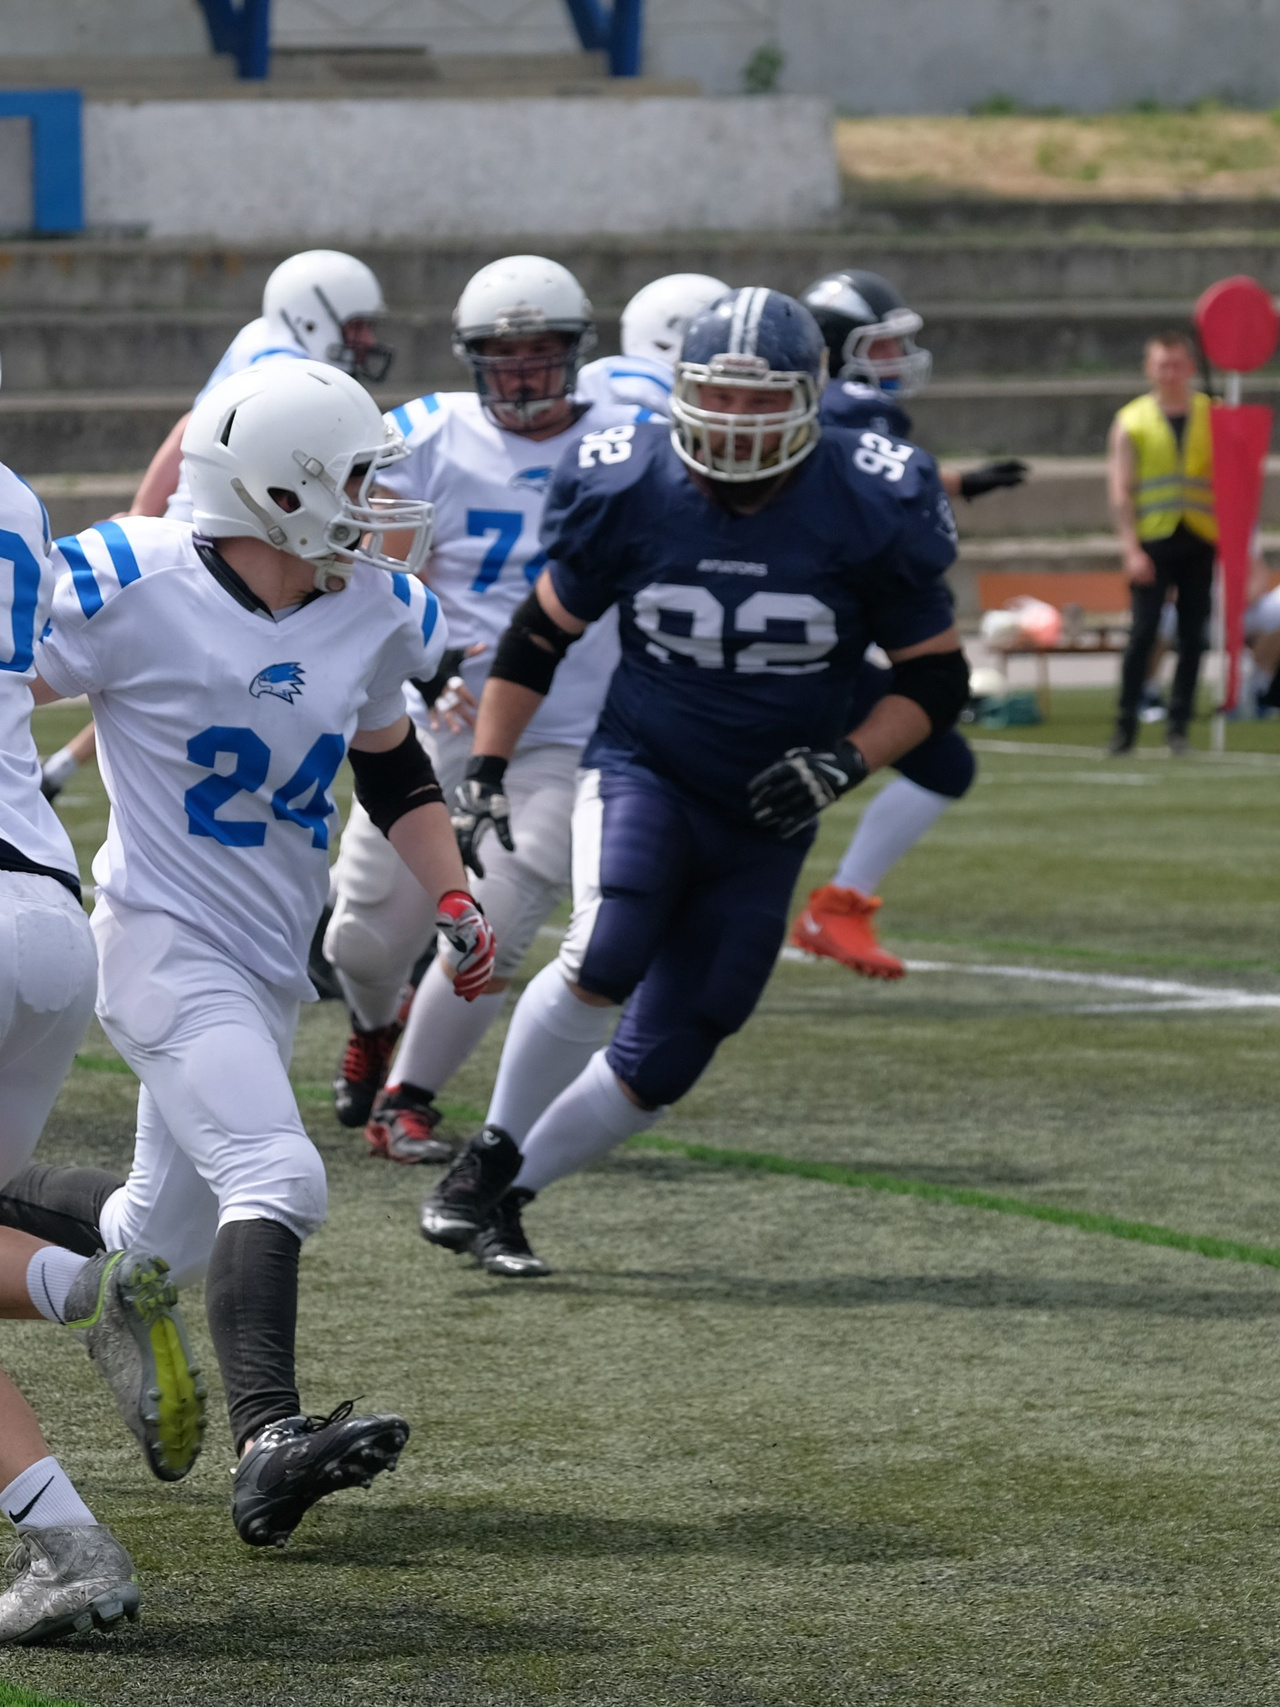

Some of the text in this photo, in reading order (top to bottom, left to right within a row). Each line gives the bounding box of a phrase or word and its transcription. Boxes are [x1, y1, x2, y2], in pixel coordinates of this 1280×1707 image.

[852, 432, 914, 482] 92
[632, 582, 839, 675] 92
[184, 725, 345, 850] 24
